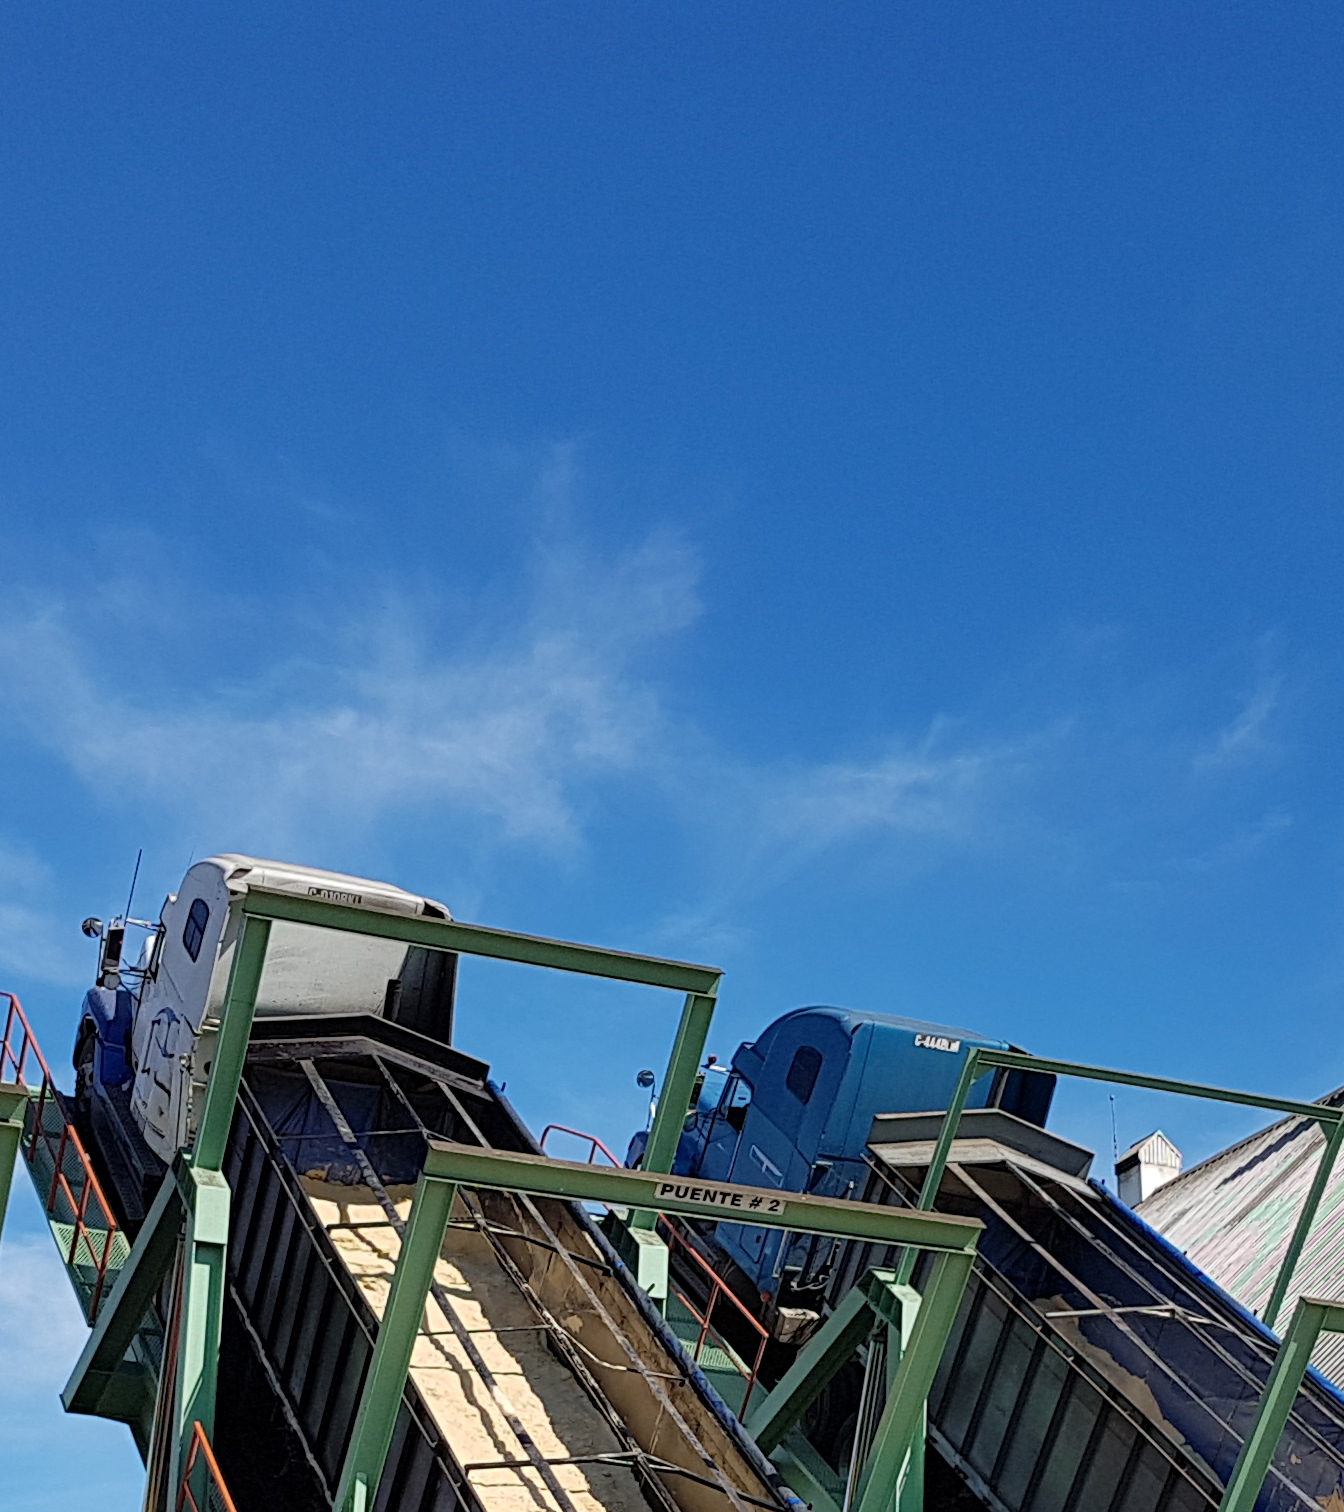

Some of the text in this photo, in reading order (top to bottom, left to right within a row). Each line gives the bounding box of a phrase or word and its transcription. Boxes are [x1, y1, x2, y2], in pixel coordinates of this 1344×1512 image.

[660, 1183, 780, 1212] PUENTE # 2
